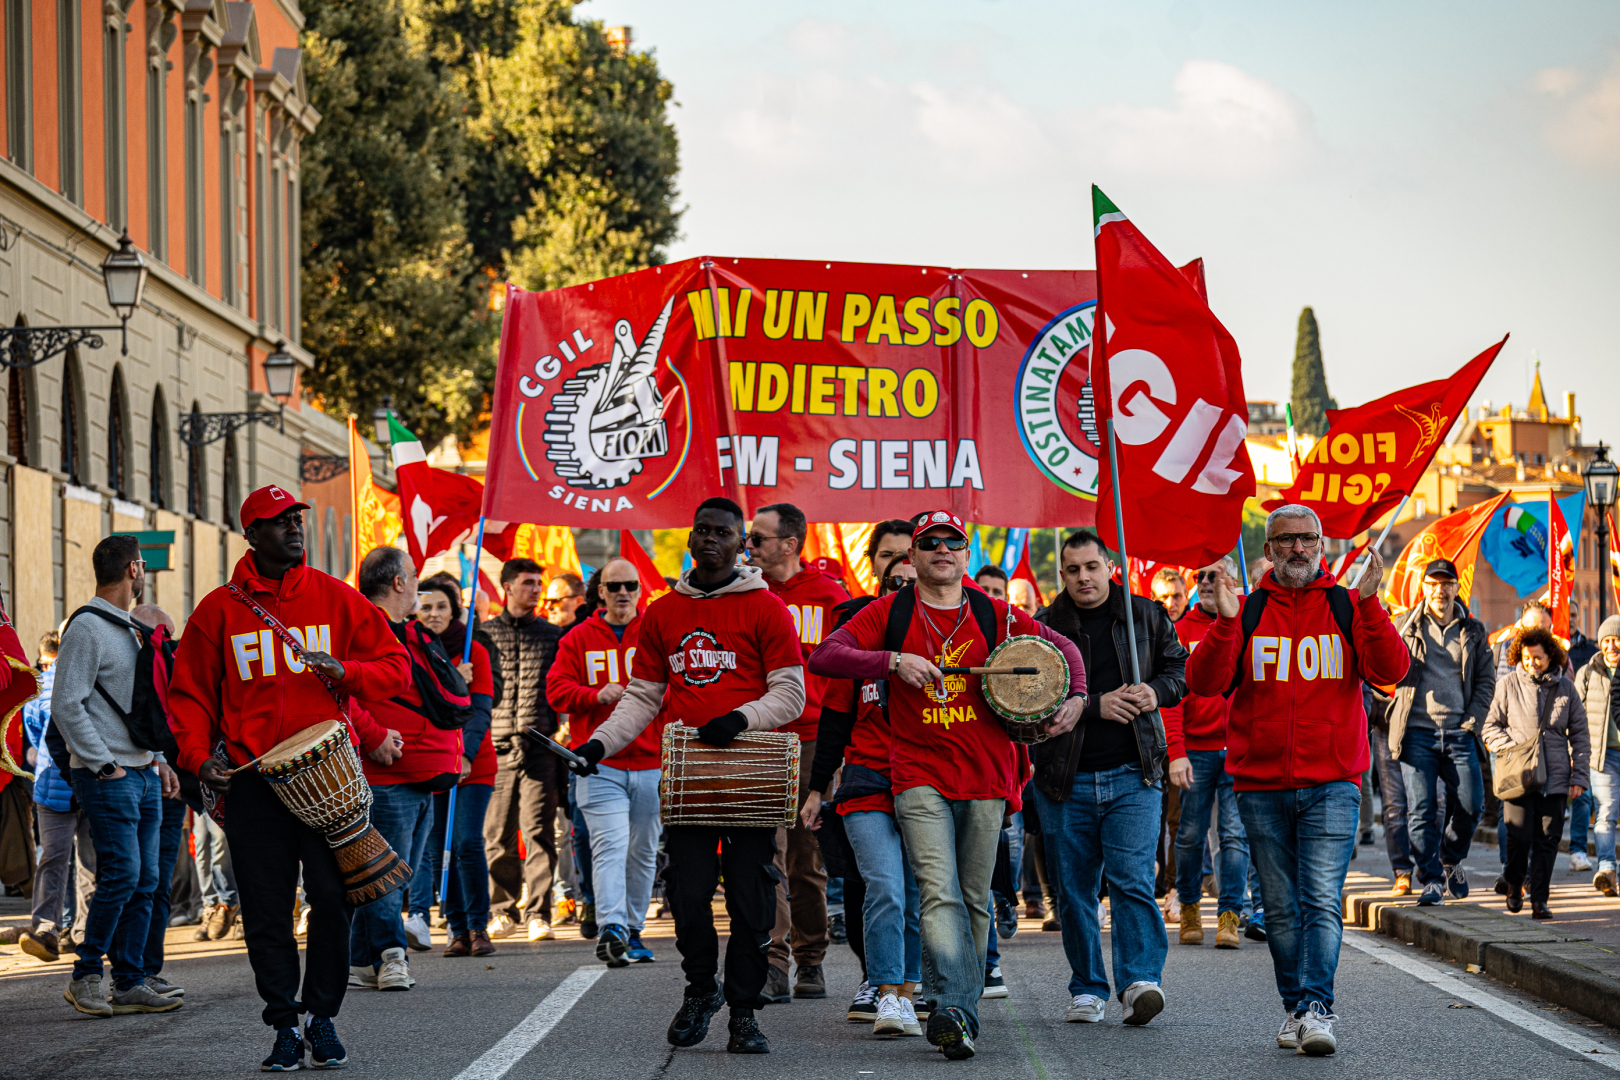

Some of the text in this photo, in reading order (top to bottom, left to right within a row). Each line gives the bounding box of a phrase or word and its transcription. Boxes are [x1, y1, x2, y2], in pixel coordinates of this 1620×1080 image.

[762, 288, 828, 341] UN
[840, 292, 1000, 349] PASSO
[518, 328, 595, 398] CGIL
[1026, 311, 1096, 467] OSTINATAM
[602, 428, 662, 457] FIOM
[828, 438, 985, 491] SIENA
[548, 484, 634, 513] SIENA
[230, 624, 332, 681] FIOM
[689, 649, 737, 670] SCIOPERO
[1252, 633, 1343, 682] FIOM
[922, 705, 978, 724] SIENA
